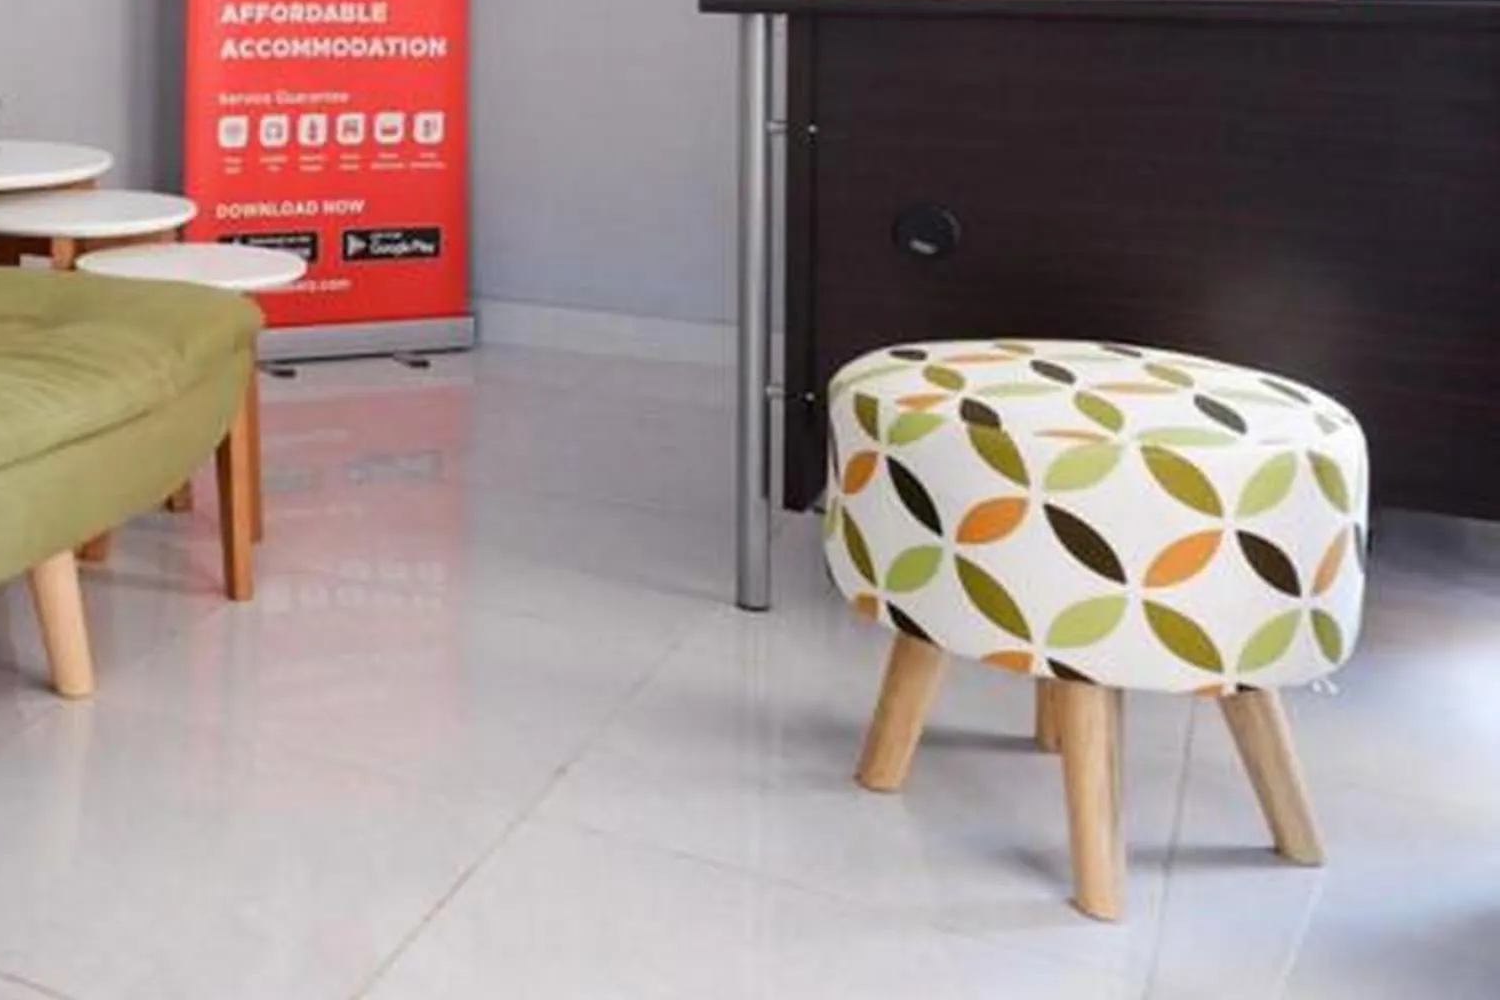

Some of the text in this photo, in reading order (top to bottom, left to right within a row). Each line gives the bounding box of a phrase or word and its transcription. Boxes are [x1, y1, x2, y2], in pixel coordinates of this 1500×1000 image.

[220, 2, 388, 23] AFFORDABLE
[220, 37, 446, 59] ACCOMMODATION
[215, 199, 366, 220] DOWNLOAD NOW
